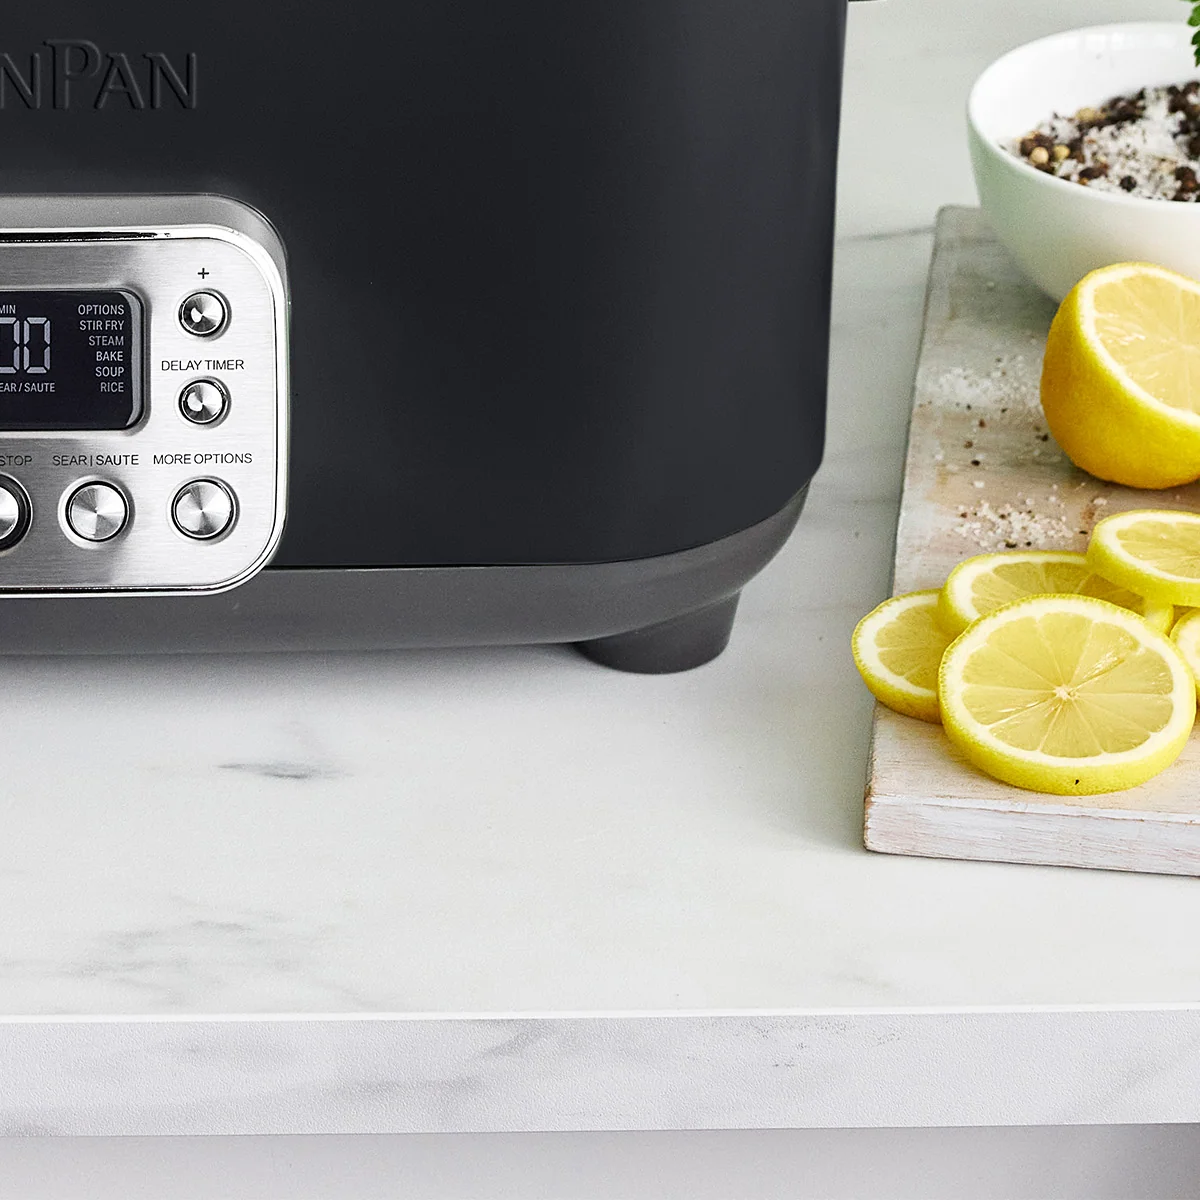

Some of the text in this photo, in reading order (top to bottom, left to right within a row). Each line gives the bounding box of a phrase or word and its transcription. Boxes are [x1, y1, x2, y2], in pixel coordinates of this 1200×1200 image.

[78, 304, 125, 315] OPTIONS
[79, 320, 125, 331] STIR FRY
[88, 335, 124, 346] STEAM
[96, 351, 124, 362] BAKE
[161, 359, 245, 371] DELAY TIMER
[95, 366, 124, 377] SOUP
[24, 382, 56, 393] SAUTE
[100, 381, 125, 392] RICE
[52, 455, 88, 467] SEAR
[96, 455, 139, 467] SAUTE
[153, 453, 253, 465] MORE OPTIONS
